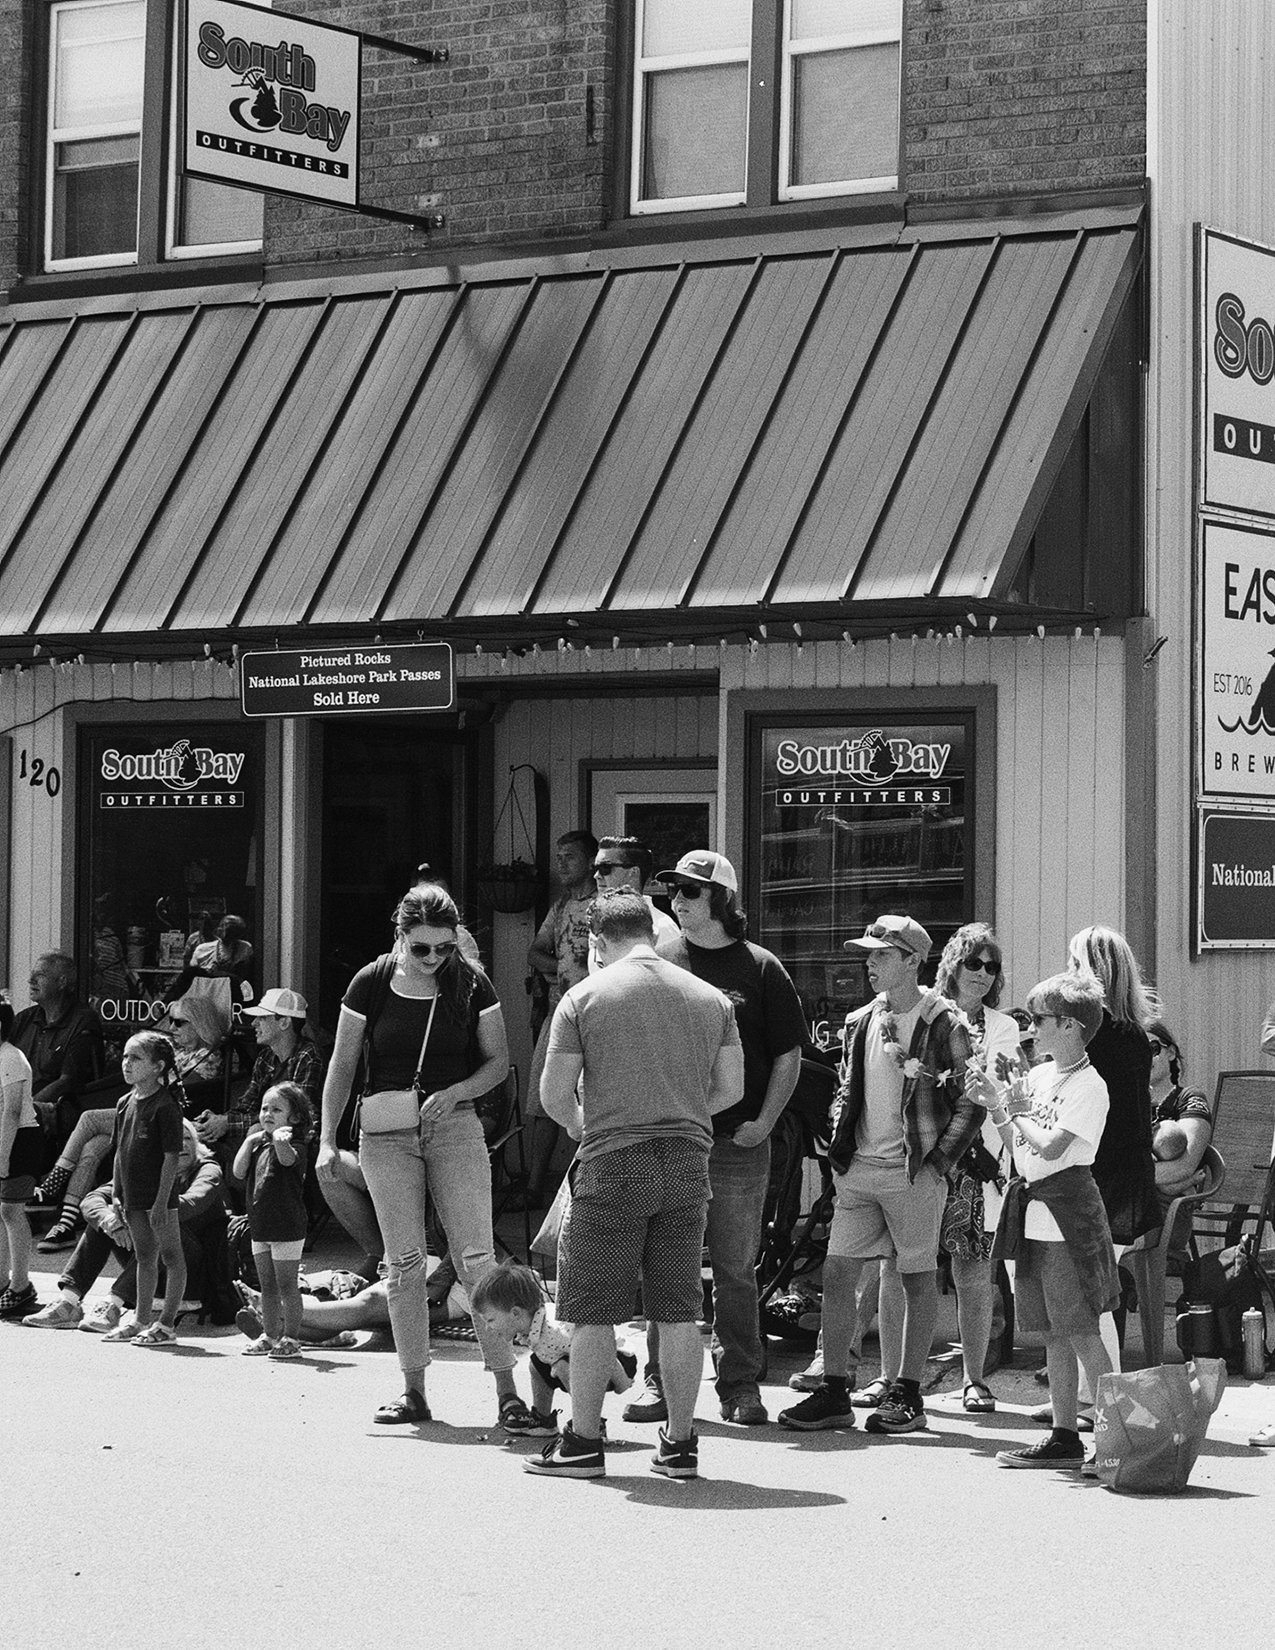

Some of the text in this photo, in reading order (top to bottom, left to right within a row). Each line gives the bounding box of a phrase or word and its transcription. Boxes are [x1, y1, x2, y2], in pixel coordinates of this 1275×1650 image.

[197, 21, 316, 92] South
[279, 87, 351, 152] Bay
[202, 134, 341, 175] OUTFITTERS
[300, 652, 391, 668] Pictured Rocks
[249, 669, 441, 688] National Lakeshore Park Passes
[1214, 673, 1253, 696] EST 2016
[313, 691, 380, 706] Sold Here
[101, 748, 245, 783] South Bay
[776, 739, 950, 778] South Bay
[19, 749, 61, 798] 120
[106, 794, 237, 806] OUTFITTERS
[783, 790, 941, 804] OUTFITTERS
